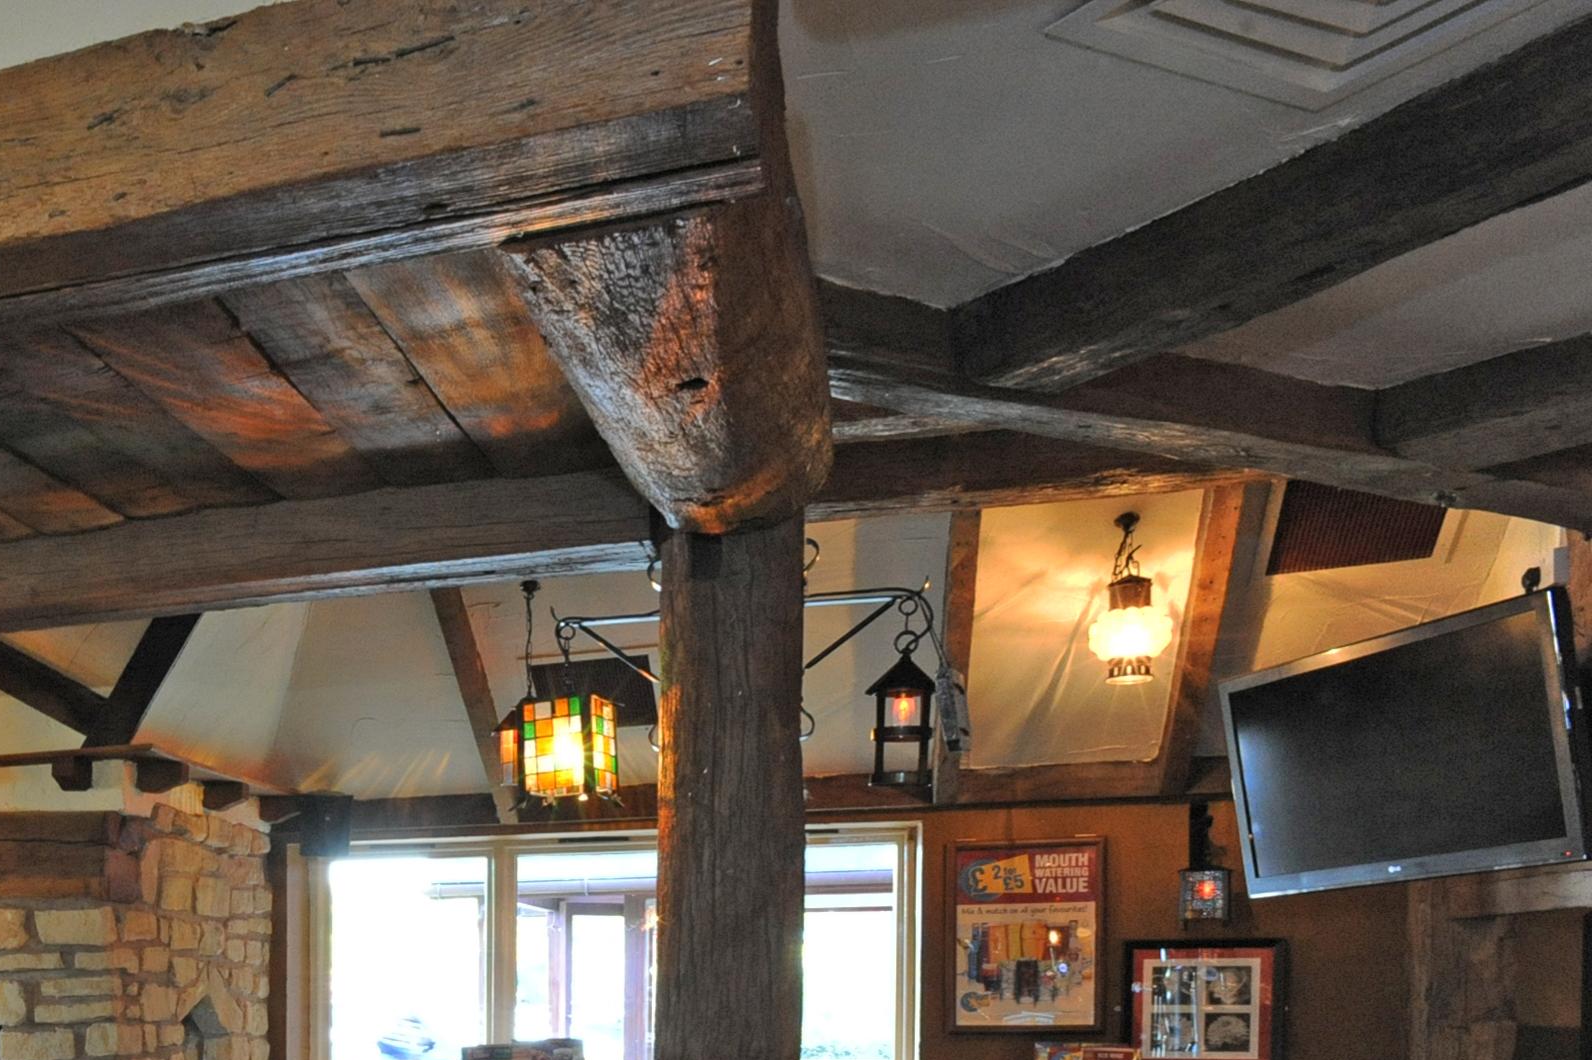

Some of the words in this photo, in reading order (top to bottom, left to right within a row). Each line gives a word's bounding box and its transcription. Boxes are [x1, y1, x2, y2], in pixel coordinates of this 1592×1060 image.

[1034, 853, 1089, 868] MOUTH
[991, 864, 1002, 880] 2
[1034, 867, 1089, 878] WATERING
[1003, 874, 1025, 891] £5
[1034, 877, 1089, 894] VALUE
